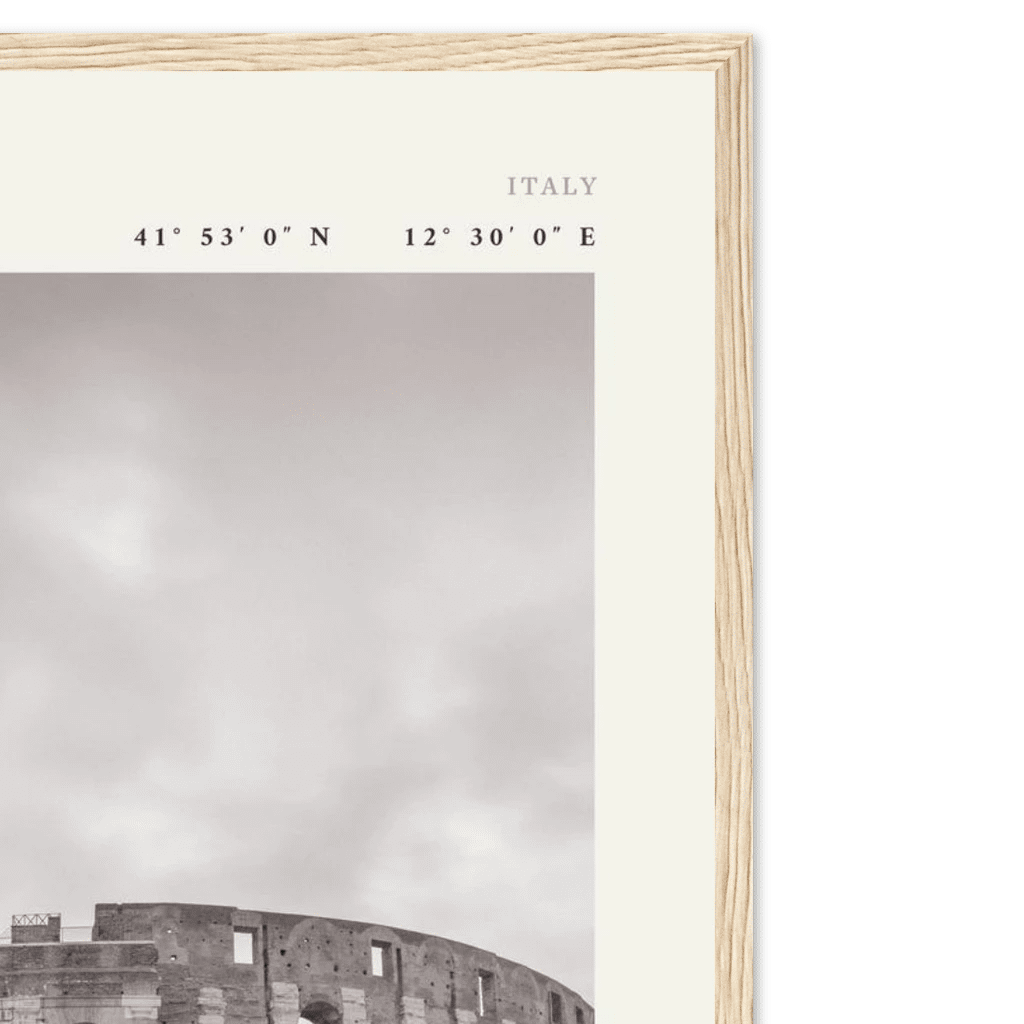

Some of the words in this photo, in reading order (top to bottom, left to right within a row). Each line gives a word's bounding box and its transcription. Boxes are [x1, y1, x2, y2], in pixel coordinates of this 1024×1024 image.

[507, 176, 598, 196] ITALY
[133, 227, 181, 247] 41°
[310, 226, 330, 247] N
[405, 227, 451, 246] 12°
[579, 226, 595, 247] E
